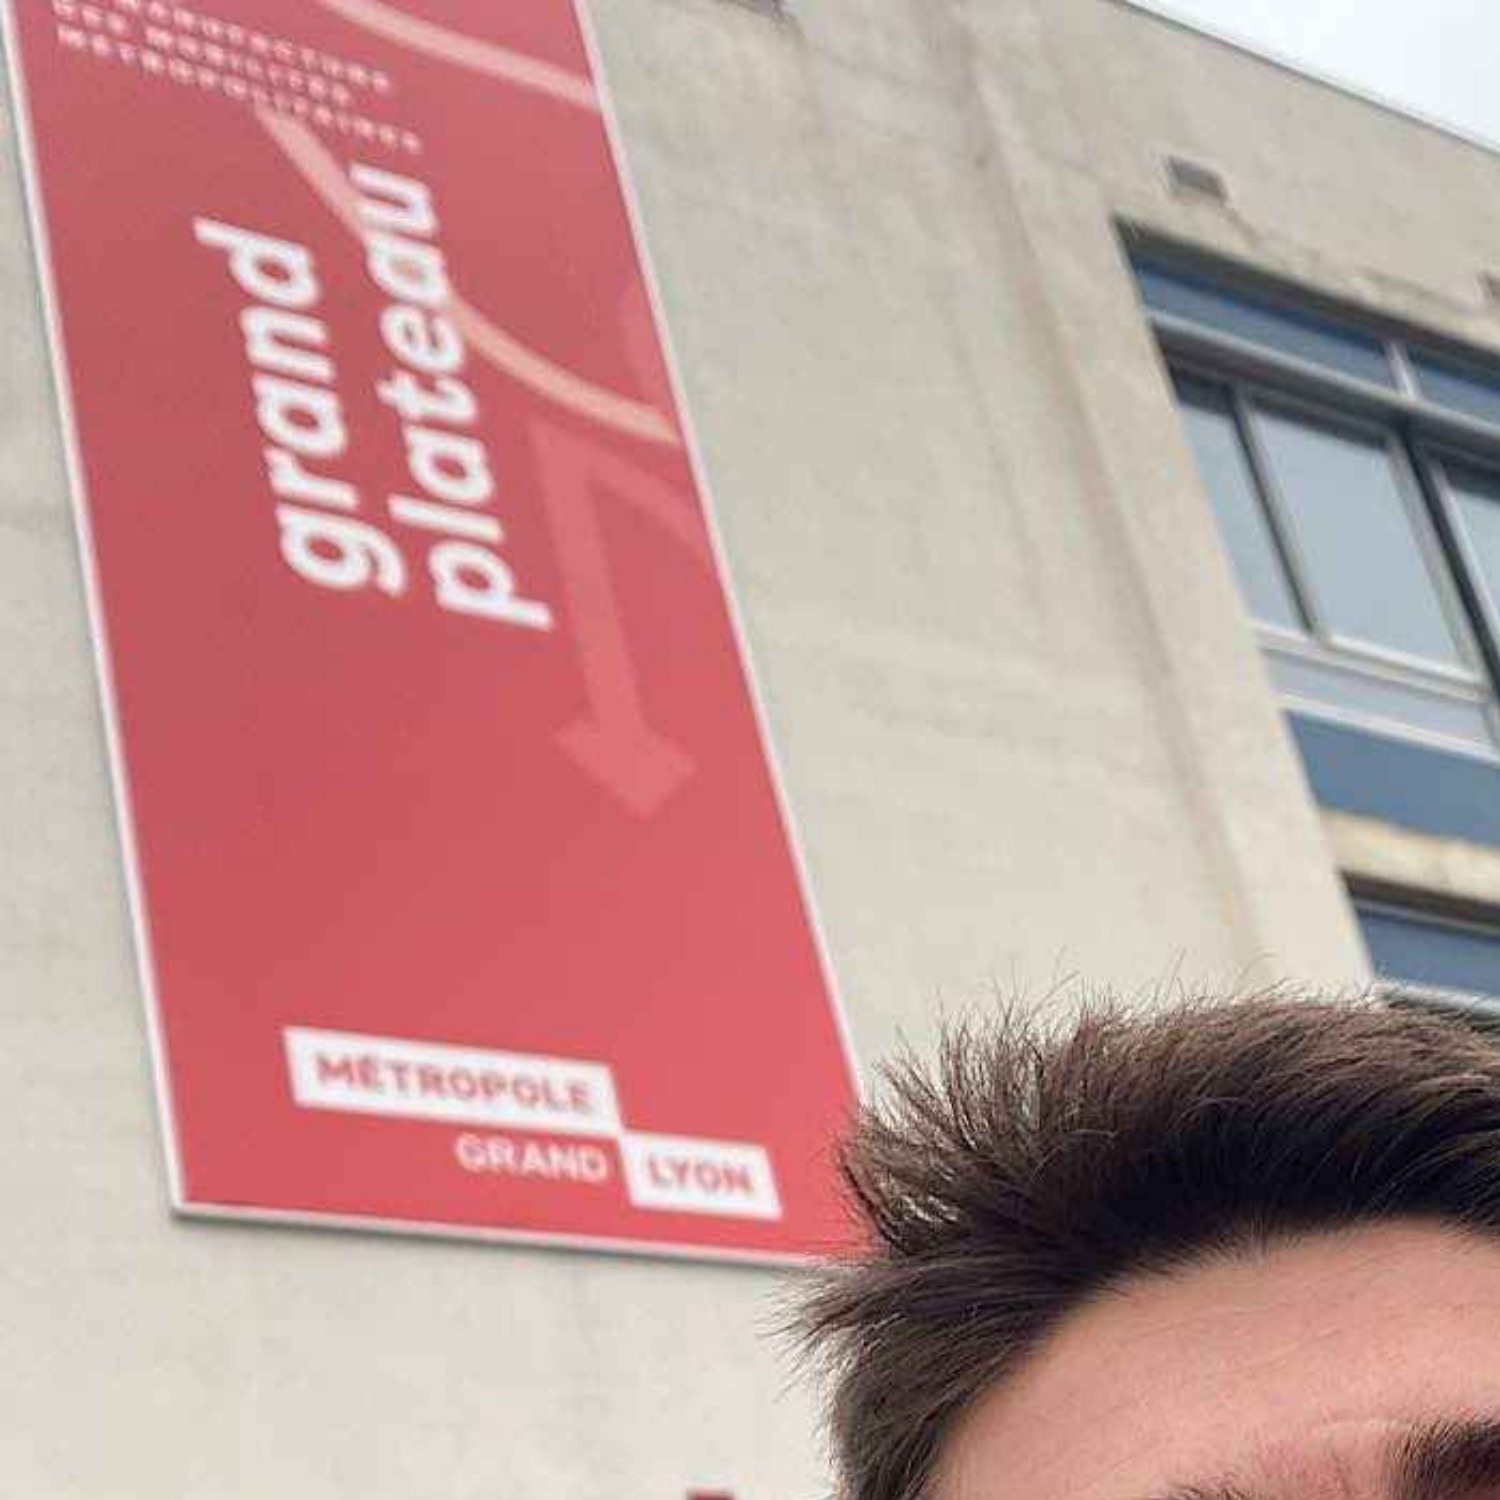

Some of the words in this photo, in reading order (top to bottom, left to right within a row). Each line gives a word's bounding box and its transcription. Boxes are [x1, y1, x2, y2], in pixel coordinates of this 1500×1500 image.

[192, 216, 409, 596] grand
[349, 162, 553, 632] plateau
[314, 1051, 593, 1114] MÉTROPOLE
[454, 1132, 608, 1182] GRAND
[646, 1153, 755, 1197] LYON
